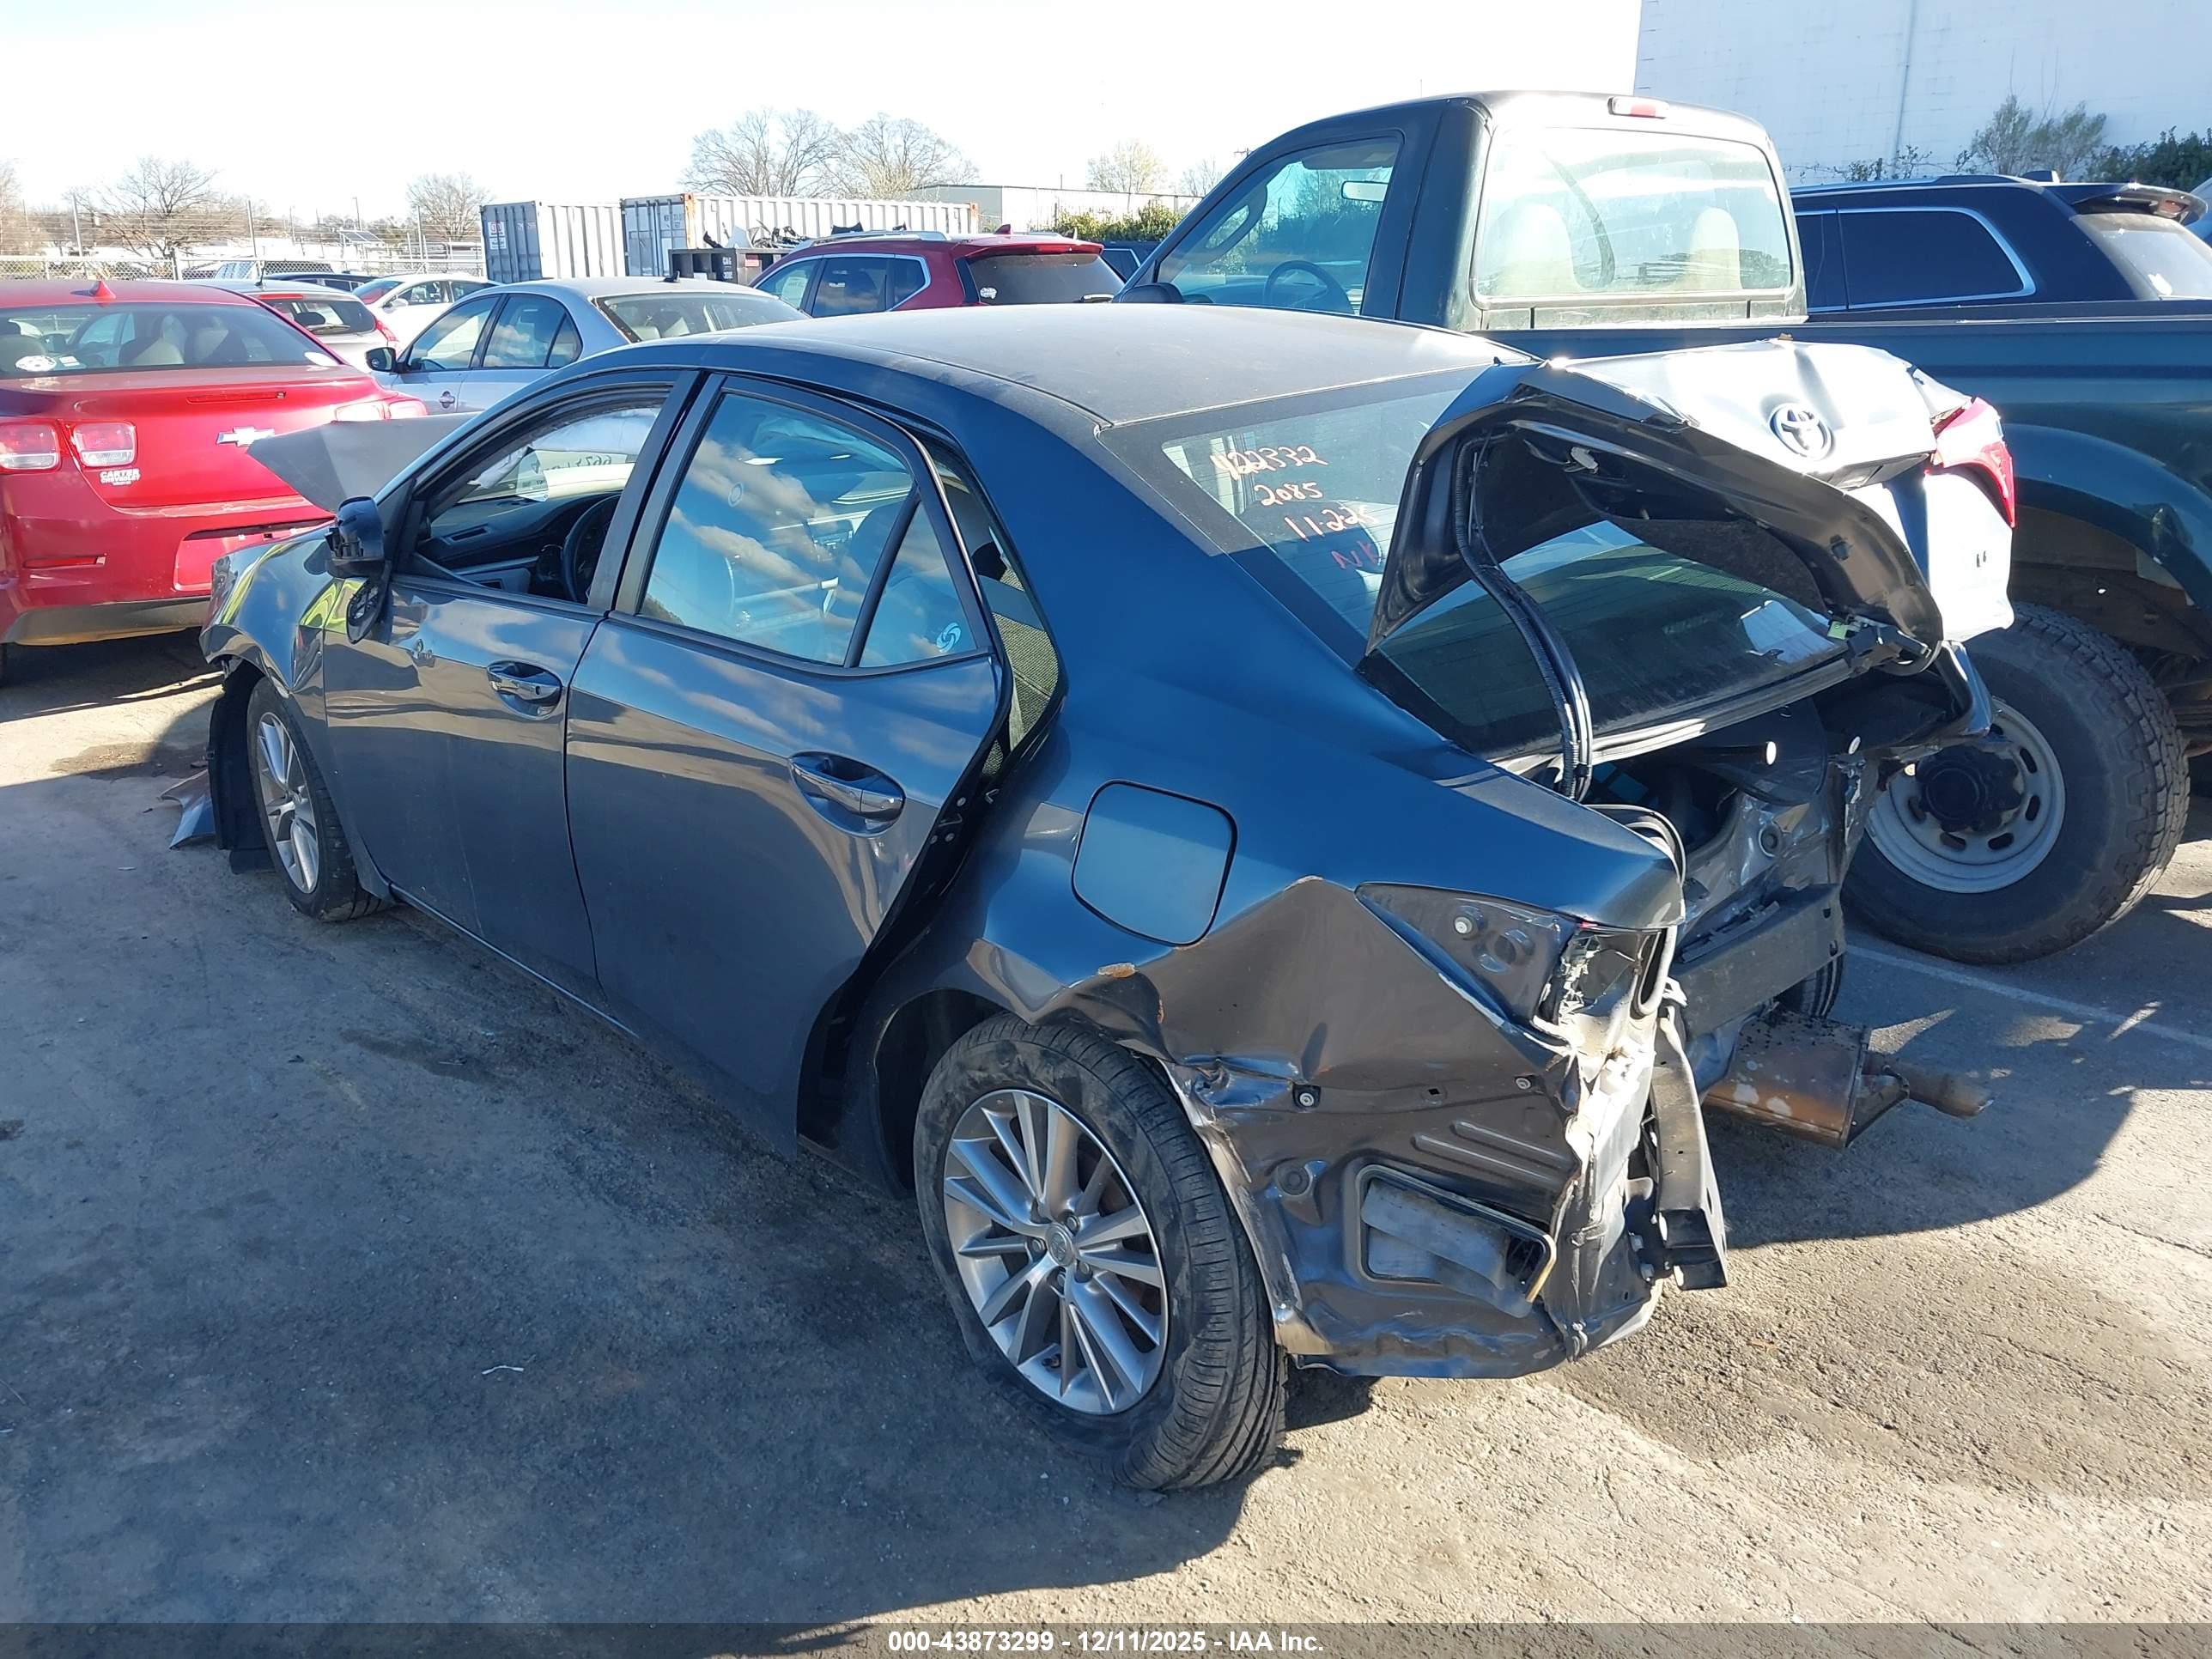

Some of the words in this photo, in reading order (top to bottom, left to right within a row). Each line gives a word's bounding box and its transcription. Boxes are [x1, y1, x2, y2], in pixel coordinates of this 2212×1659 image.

[100, 468, 139, 477] CARTER
[1209, 445, 1329, 481] 422332
[1254, 482, 1323, 506] 2085
